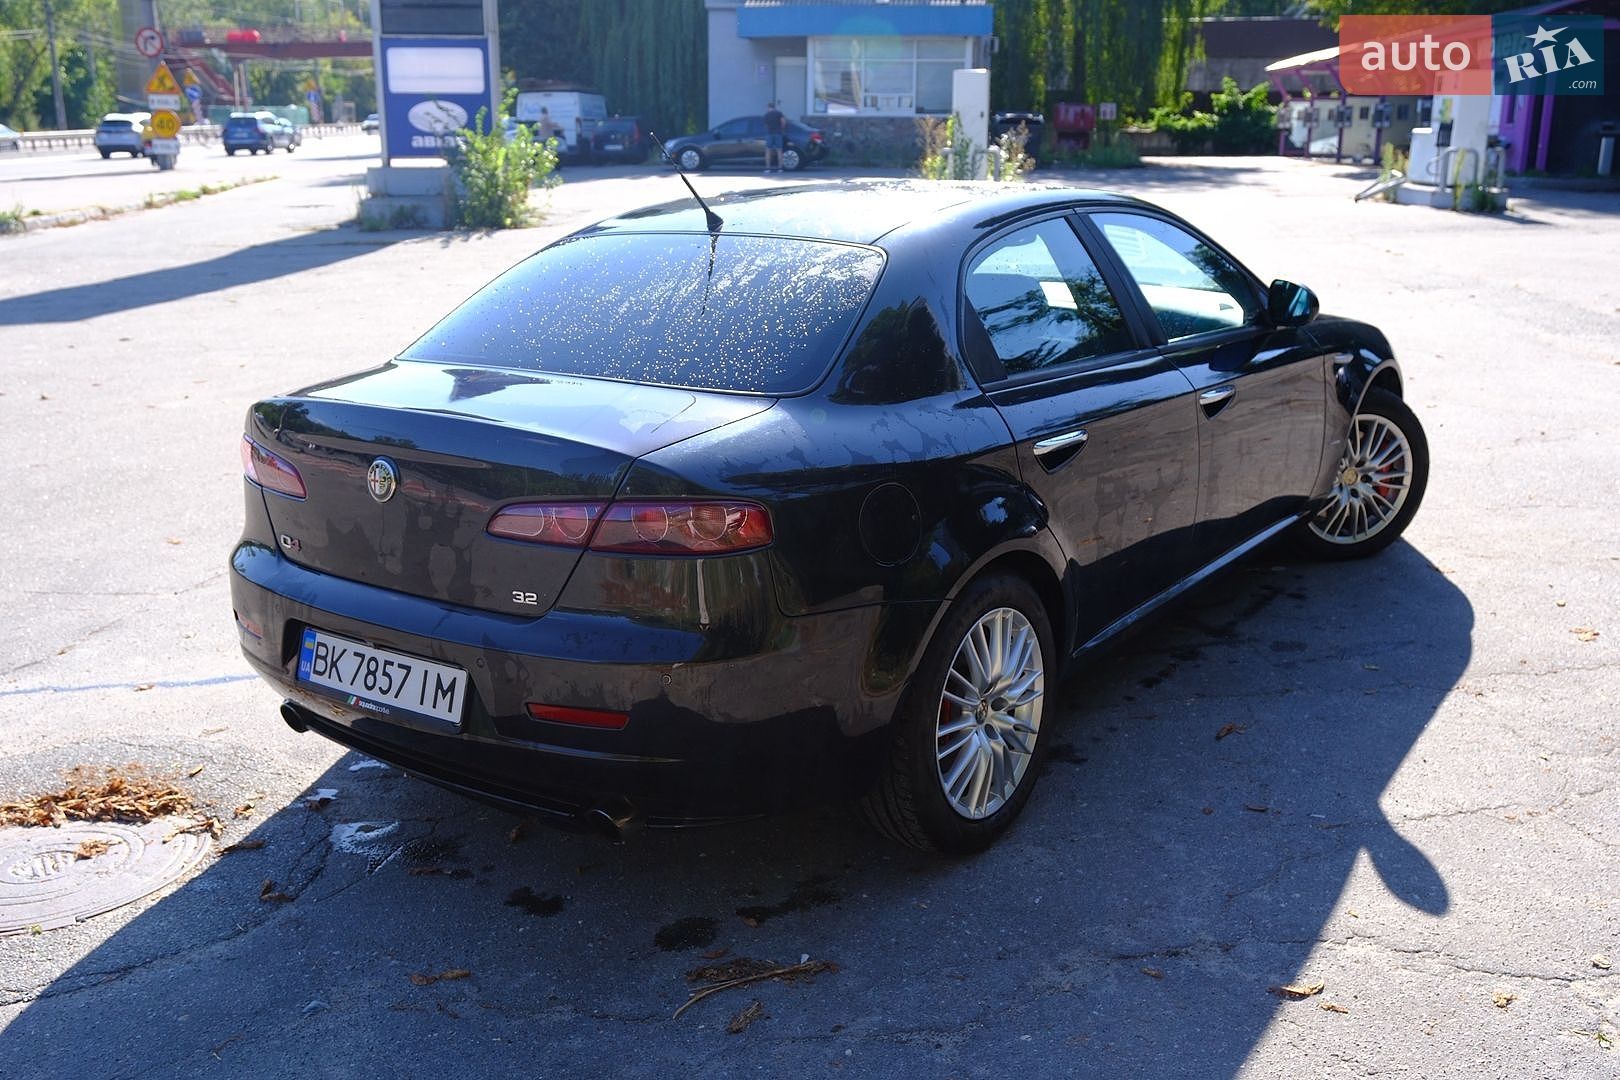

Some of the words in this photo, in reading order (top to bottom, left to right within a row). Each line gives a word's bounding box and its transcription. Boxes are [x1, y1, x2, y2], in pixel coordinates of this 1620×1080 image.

[157, 118, 174, 130] 40
[301, 661, 310, 673] UA
[312, 642, 347, 683] BK
[350, 651, 411, 699] 7857
[419, 669, 457, 713] IM
